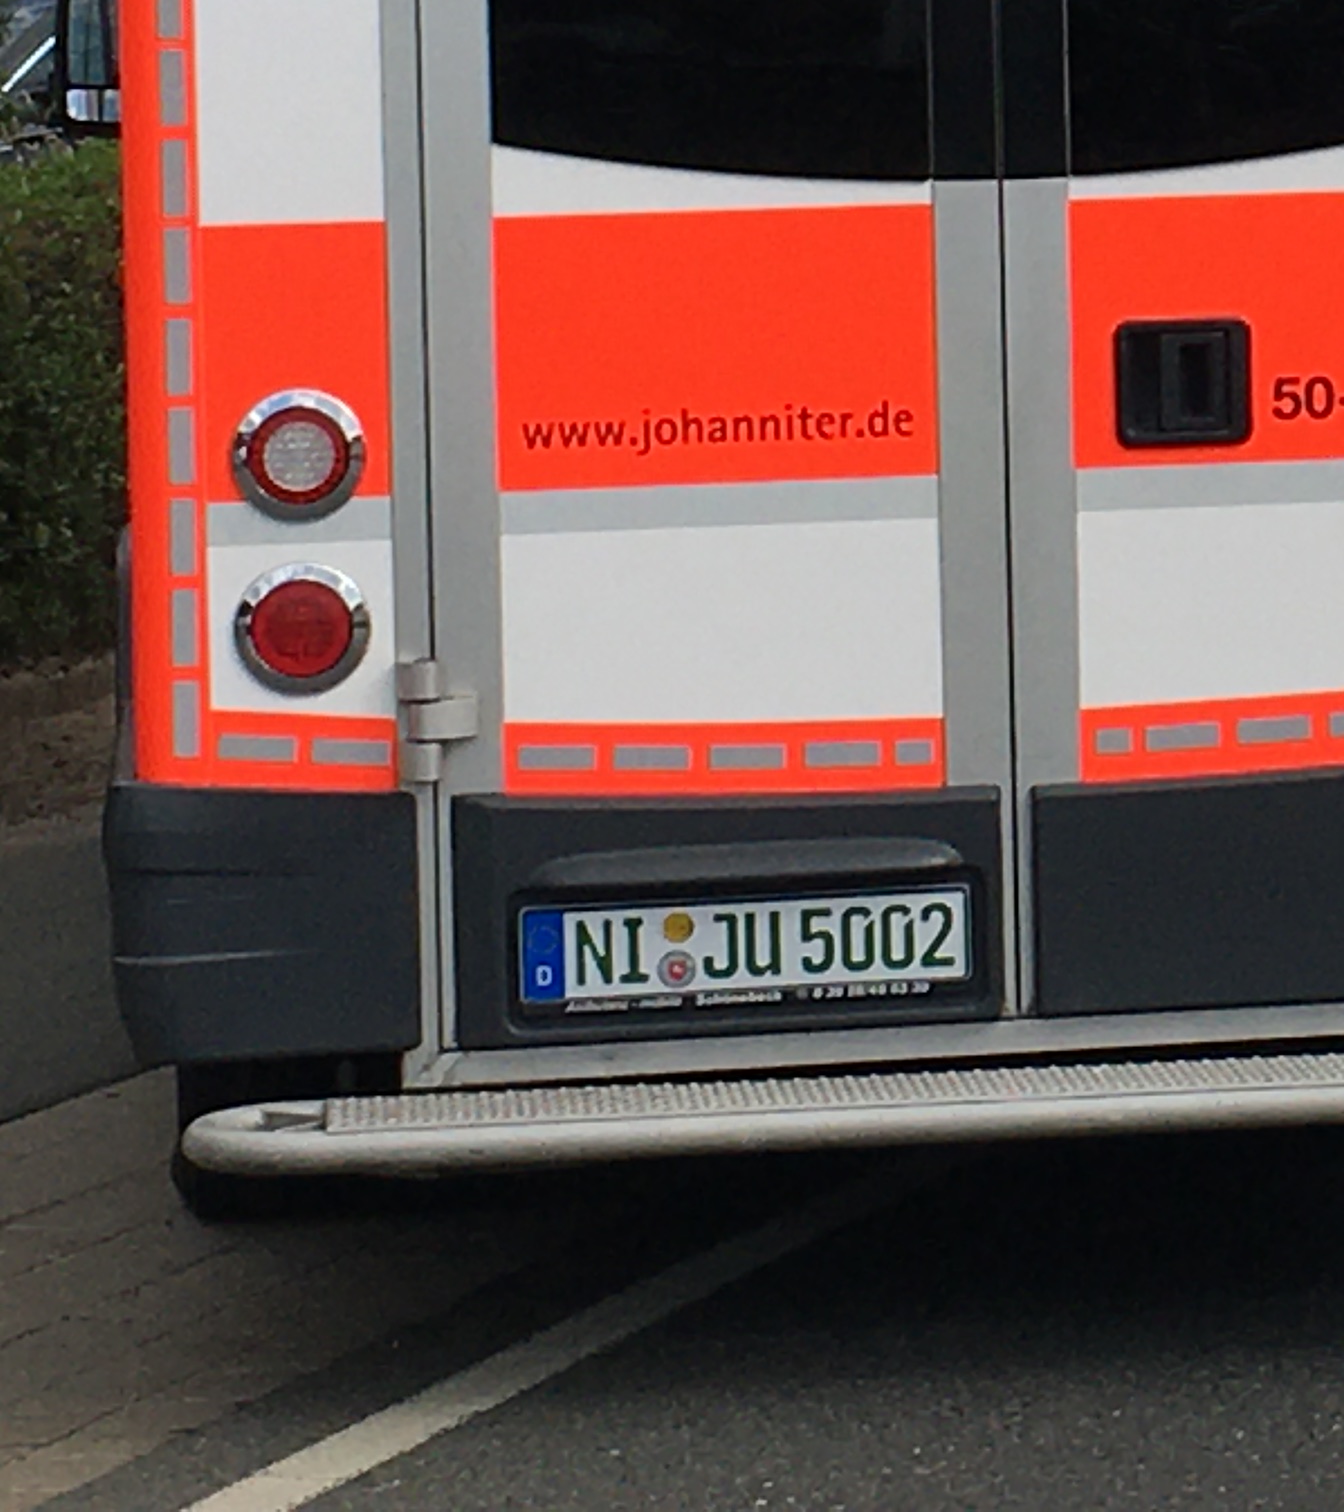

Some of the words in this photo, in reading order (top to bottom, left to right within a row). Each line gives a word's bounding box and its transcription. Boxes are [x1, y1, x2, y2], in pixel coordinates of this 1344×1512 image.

[522, 400, 914, 457] www.johanniter.de
[574, 917, 650, 987] NI
[702, 910, 782, 979] JU
[801, 901, 957, 975] 5002
